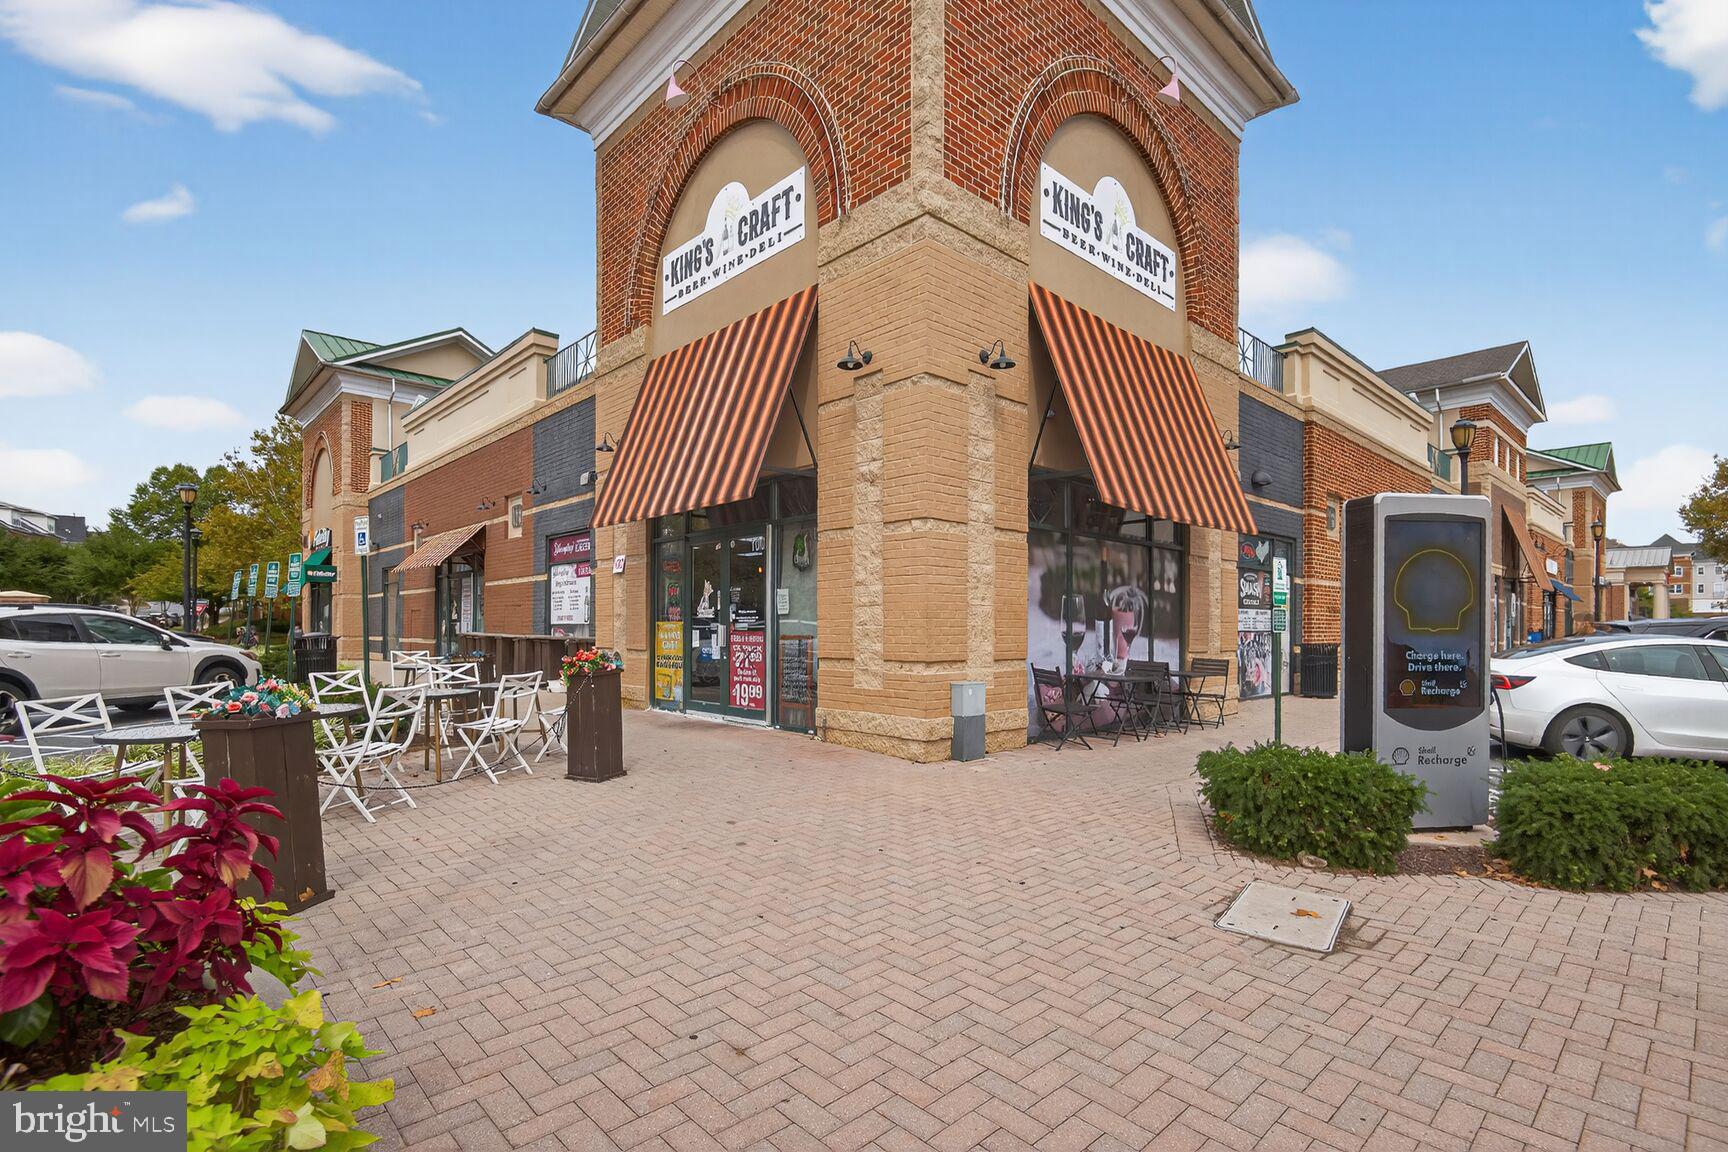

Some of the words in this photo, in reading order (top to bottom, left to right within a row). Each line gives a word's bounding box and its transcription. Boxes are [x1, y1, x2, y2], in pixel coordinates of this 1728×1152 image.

[671, 237, 714, 288] KING'S
[737, 185, 795, 247] CRAFT
[1052, 180, 1104, 242] KING'S
[1125, 232, 1170, 283] CRAFT
[1405, 650, 1439, 662] Charge
[1440, 650, 1464, 660] here.
[1407, 662, 1433, 672] Drive
[1434, 662, 1463, 672] there.
[1421, 686, 1461, 697] Recharge
[1418, 746, 1437, 754] Shell
[1418, 755, 1468, 767] Recharge
